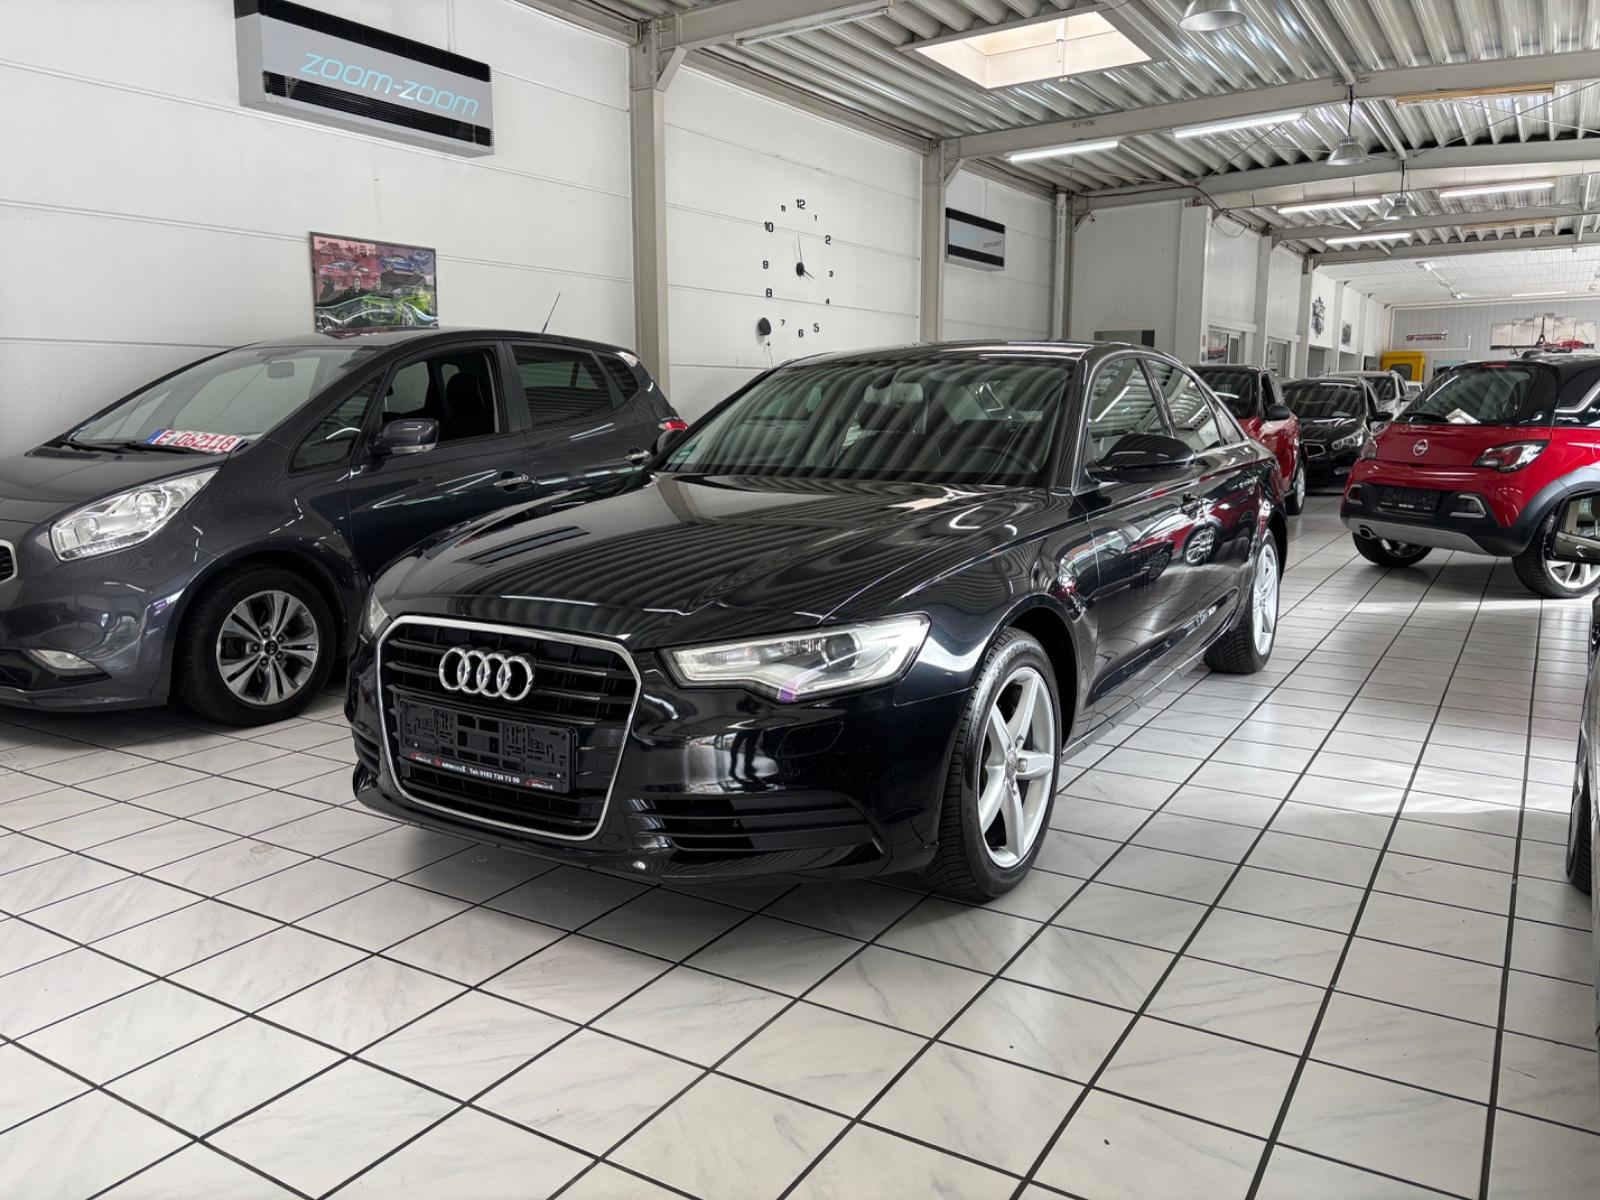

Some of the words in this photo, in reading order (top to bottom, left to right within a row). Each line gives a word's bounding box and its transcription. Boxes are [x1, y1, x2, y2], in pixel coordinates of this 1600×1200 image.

[300, 52, 479, 117] zoom-zoom
[796, 199, 806, 210] 12
[764, 222, 774, 232] 10
[825, 235, 831, 245] 2
[762, 260, 769, 269] 9
[829, 270, 834, 278] 3
[766, 288, 773, 298] 8
[813, 323, 820, 333] 5
[798, 329, 804, 338] 6
